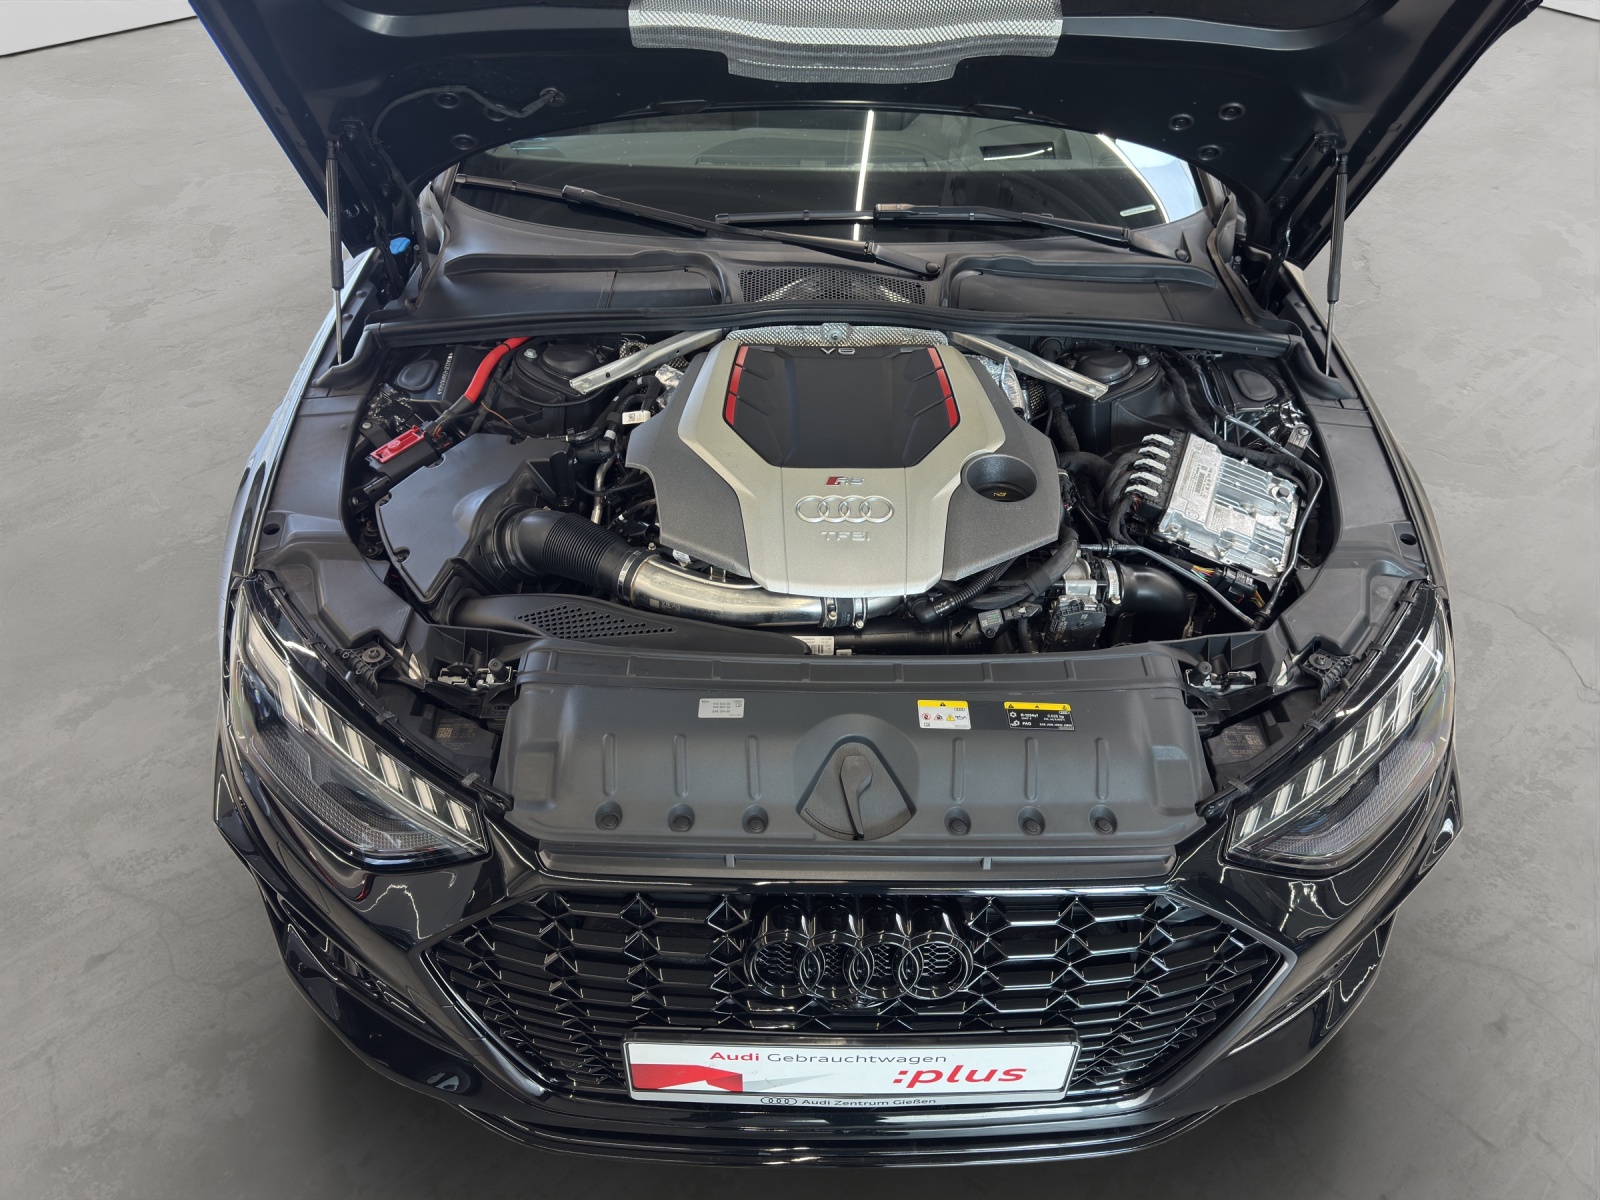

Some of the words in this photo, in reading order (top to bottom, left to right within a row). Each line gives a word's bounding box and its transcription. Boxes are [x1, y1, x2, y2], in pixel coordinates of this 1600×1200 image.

[820, 347, 856, 355] V6
[820, 531, 870, 541] TFSI
[710, 1052, 760, 1061] Audi
[767, 1054, 947, 1065] Gebrauchtwagen
[892, 1064, 1027, 1088] :plus
